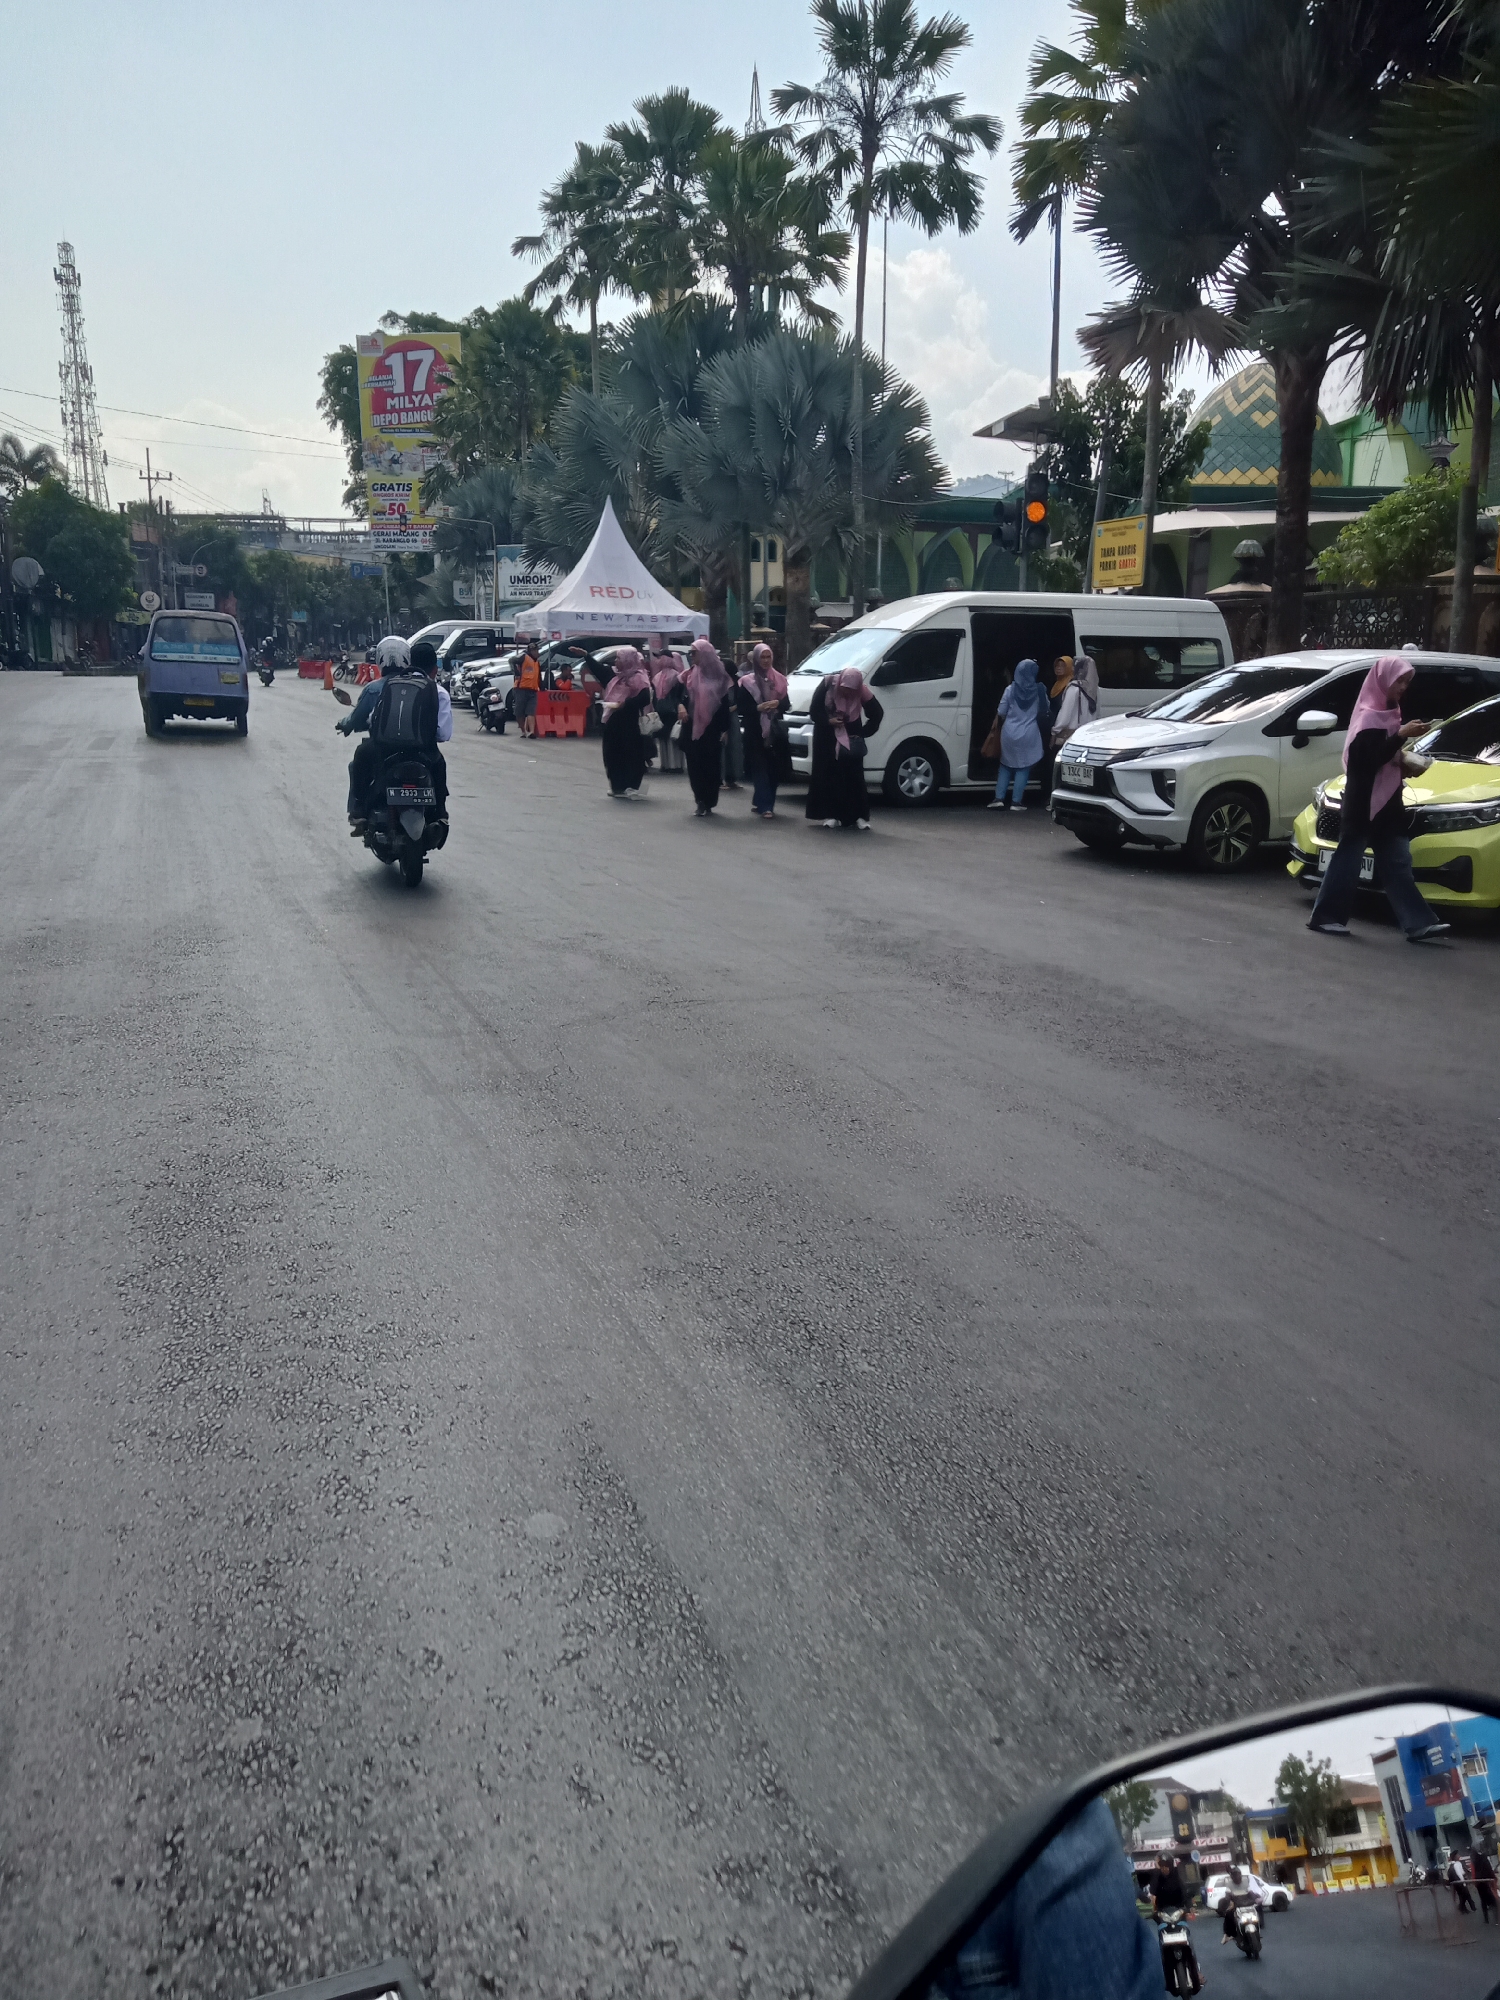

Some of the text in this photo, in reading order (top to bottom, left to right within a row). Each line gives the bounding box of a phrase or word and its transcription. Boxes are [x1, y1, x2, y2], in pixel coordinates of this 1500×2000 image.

[384, 349, 435, 394] 17
[373, 410, 434, 427] DEPO BANGU
[372, 482, 413, 492] GRATIS
[387, 502, 407, 516] 50
[1118, 558, 1137, 569] GRATIS
[509, 575, 552, 585] UMROH?
[588, 585, 635, 599] RED
[575, 613, 685, 623] NEW TASTE
[1320, 850, 1326, 864] L
